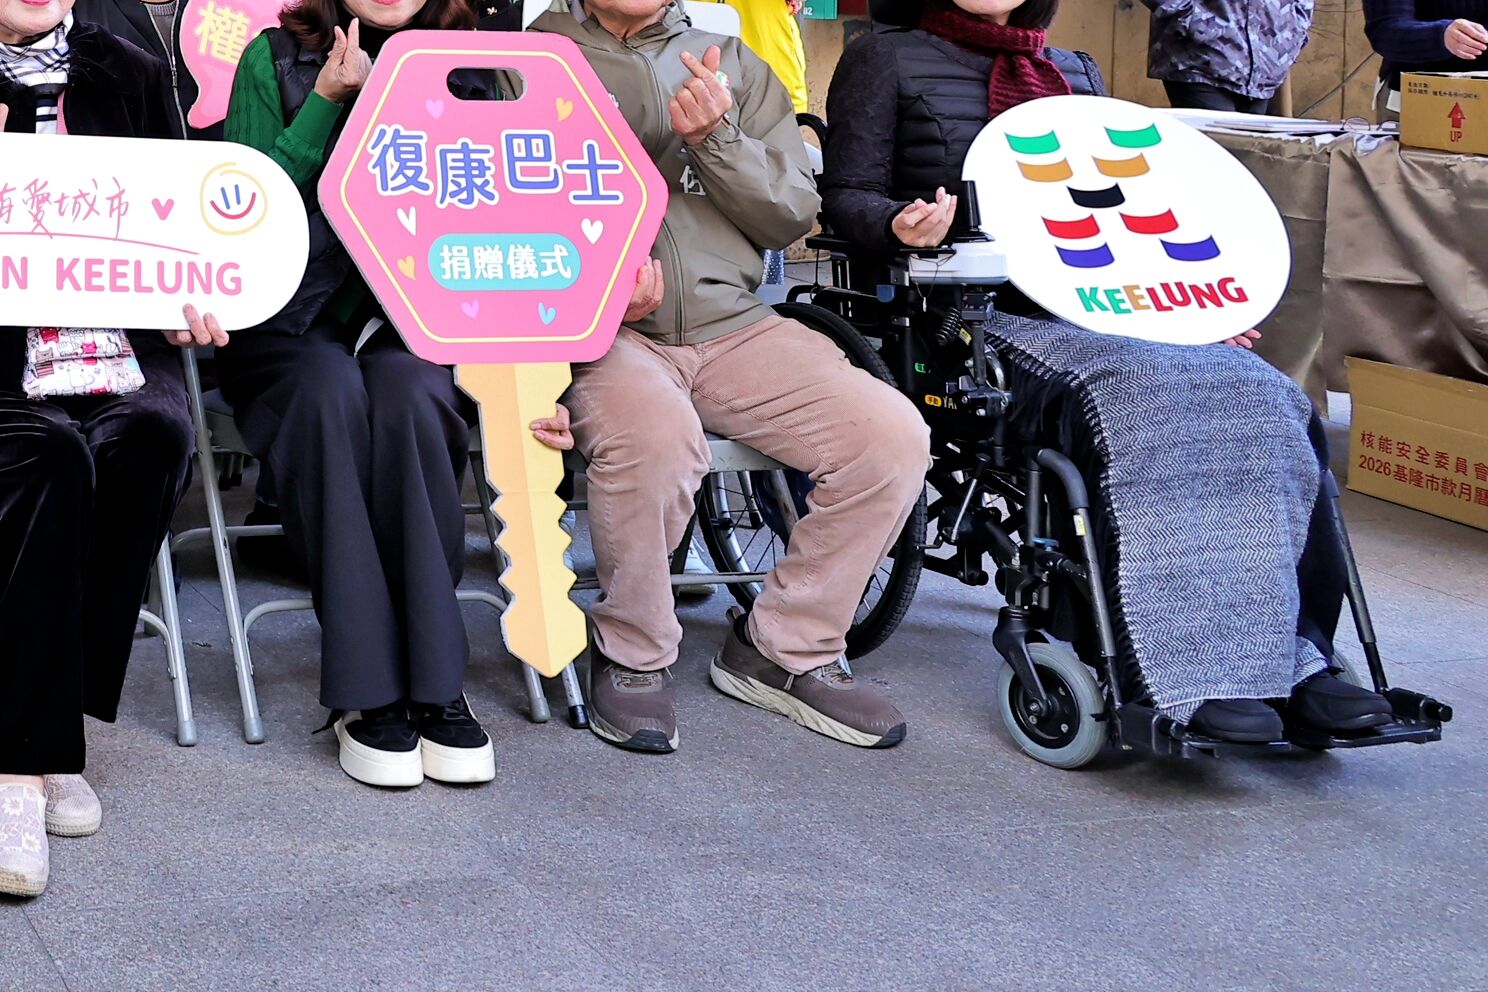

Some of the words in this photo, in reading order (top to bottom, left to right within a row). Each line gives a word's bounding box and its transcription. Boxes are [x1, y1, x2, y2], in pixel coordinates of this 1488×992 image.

[1450, 131, 1462, 142] UP
[369, 125, 622, 208] 復康巴士
[56, 257, 242, 295] KEELUNG
[439, 244, 572, 281] 捐贈儀式
[1075, 277, 1248, 314] KEELUNG
[1361, 430, 1488, 482] 核能安全委員會
